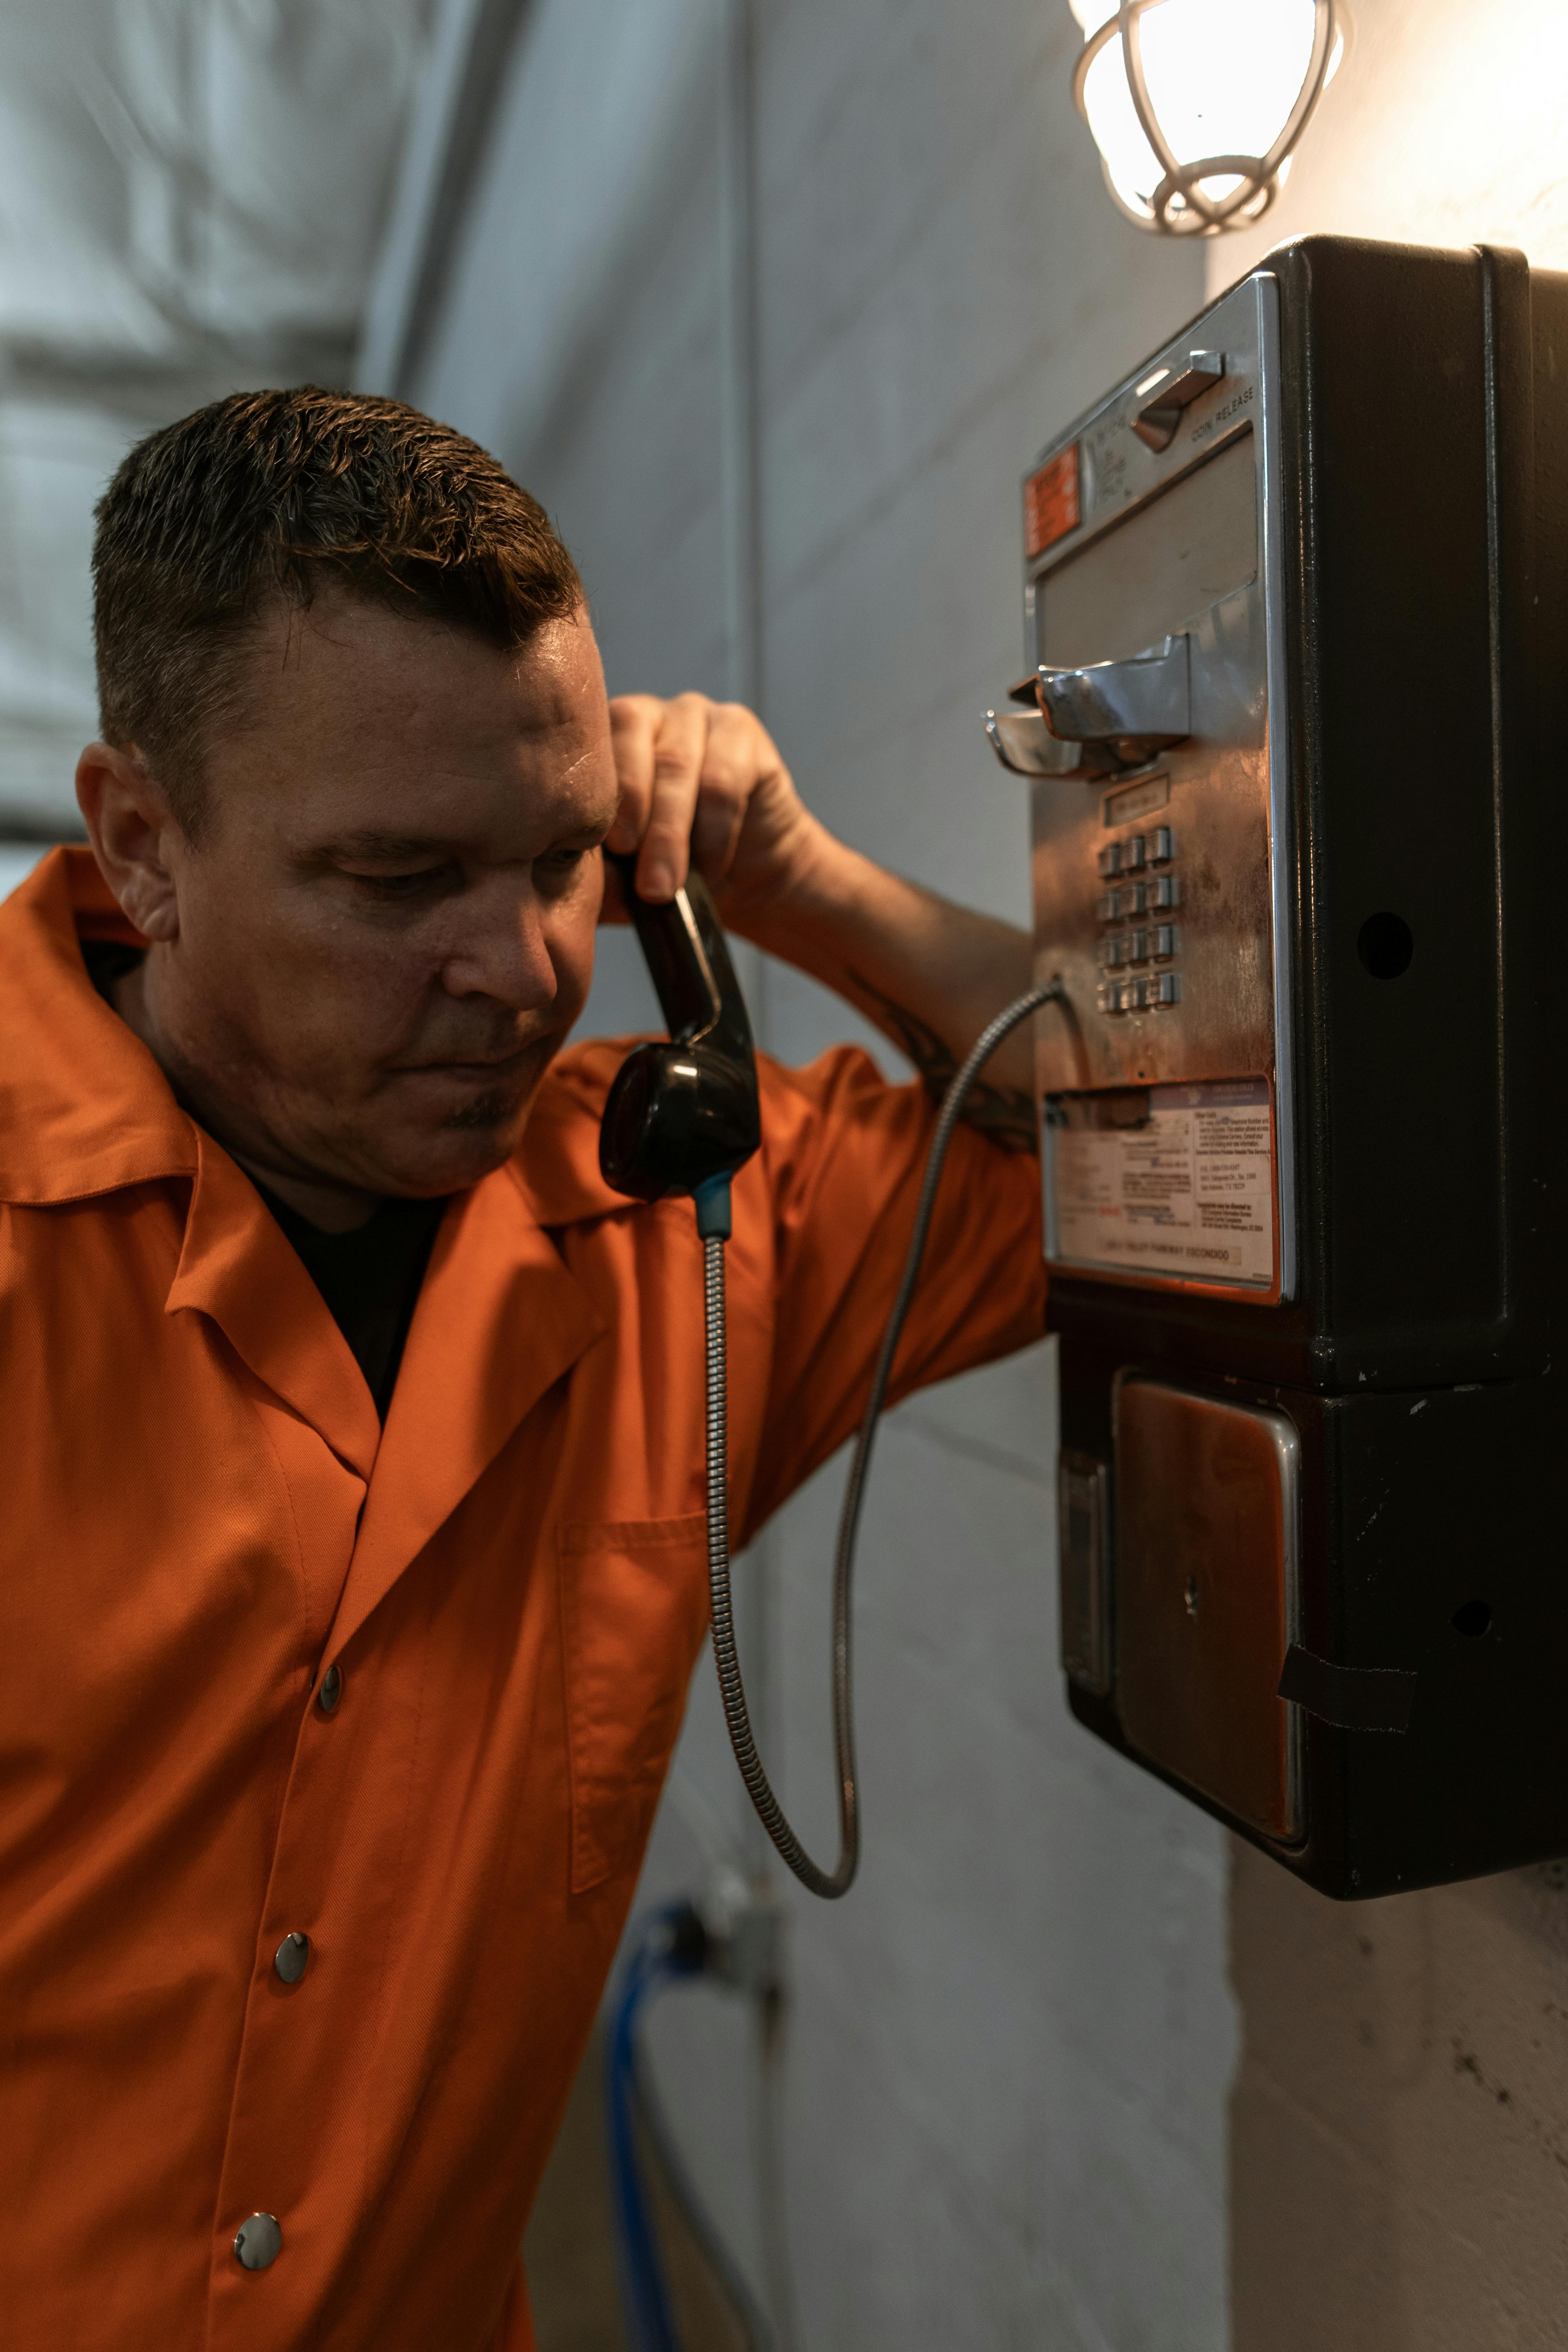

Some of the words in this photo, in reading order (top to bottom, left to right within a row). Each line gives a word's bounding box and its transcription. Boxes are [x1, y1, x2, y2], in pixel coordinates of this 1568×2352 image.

[1191, 418, 1212, 442] COIN
[1215, 387, 1253, 423] RELEASE
[1186, 1247, 1229, 1261] ESCONDIDO
